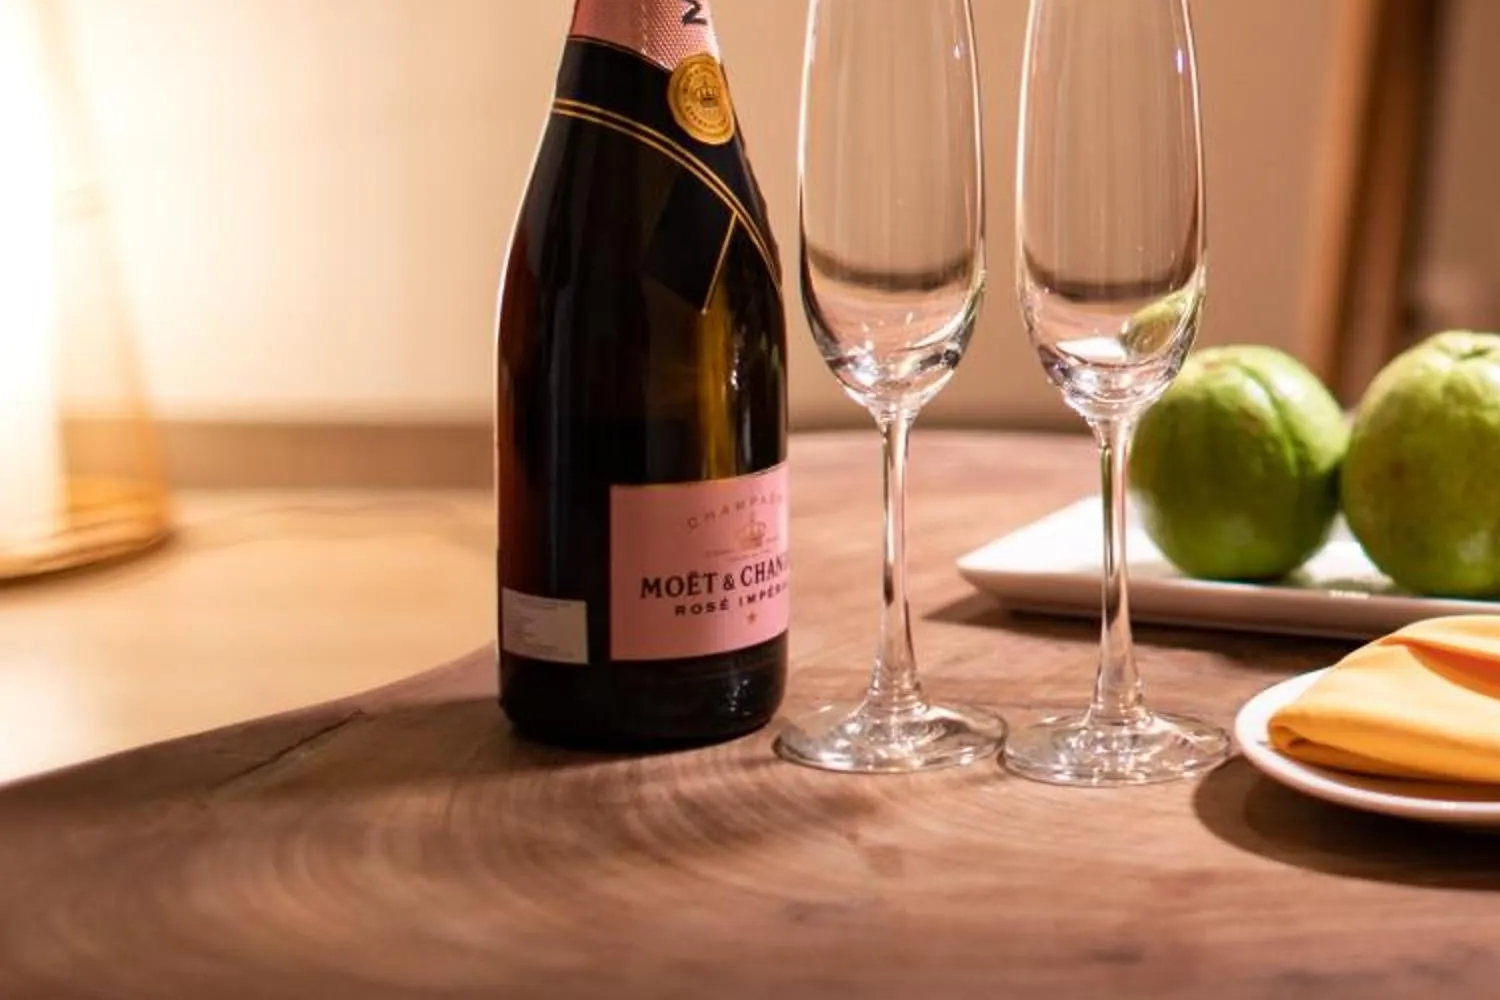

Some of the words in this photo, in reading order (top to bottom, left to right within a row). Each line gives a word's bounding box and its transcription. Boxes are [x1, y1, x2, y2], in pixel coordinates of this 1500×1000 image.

[640, 571, 718, 599] MOËT
[723, 573, 735, 591] &
[740, 555, 785, 587] CHAN
[675, 597, 729, 617] ROSÉ
[739, 582, 787, 608] IMPÉR
